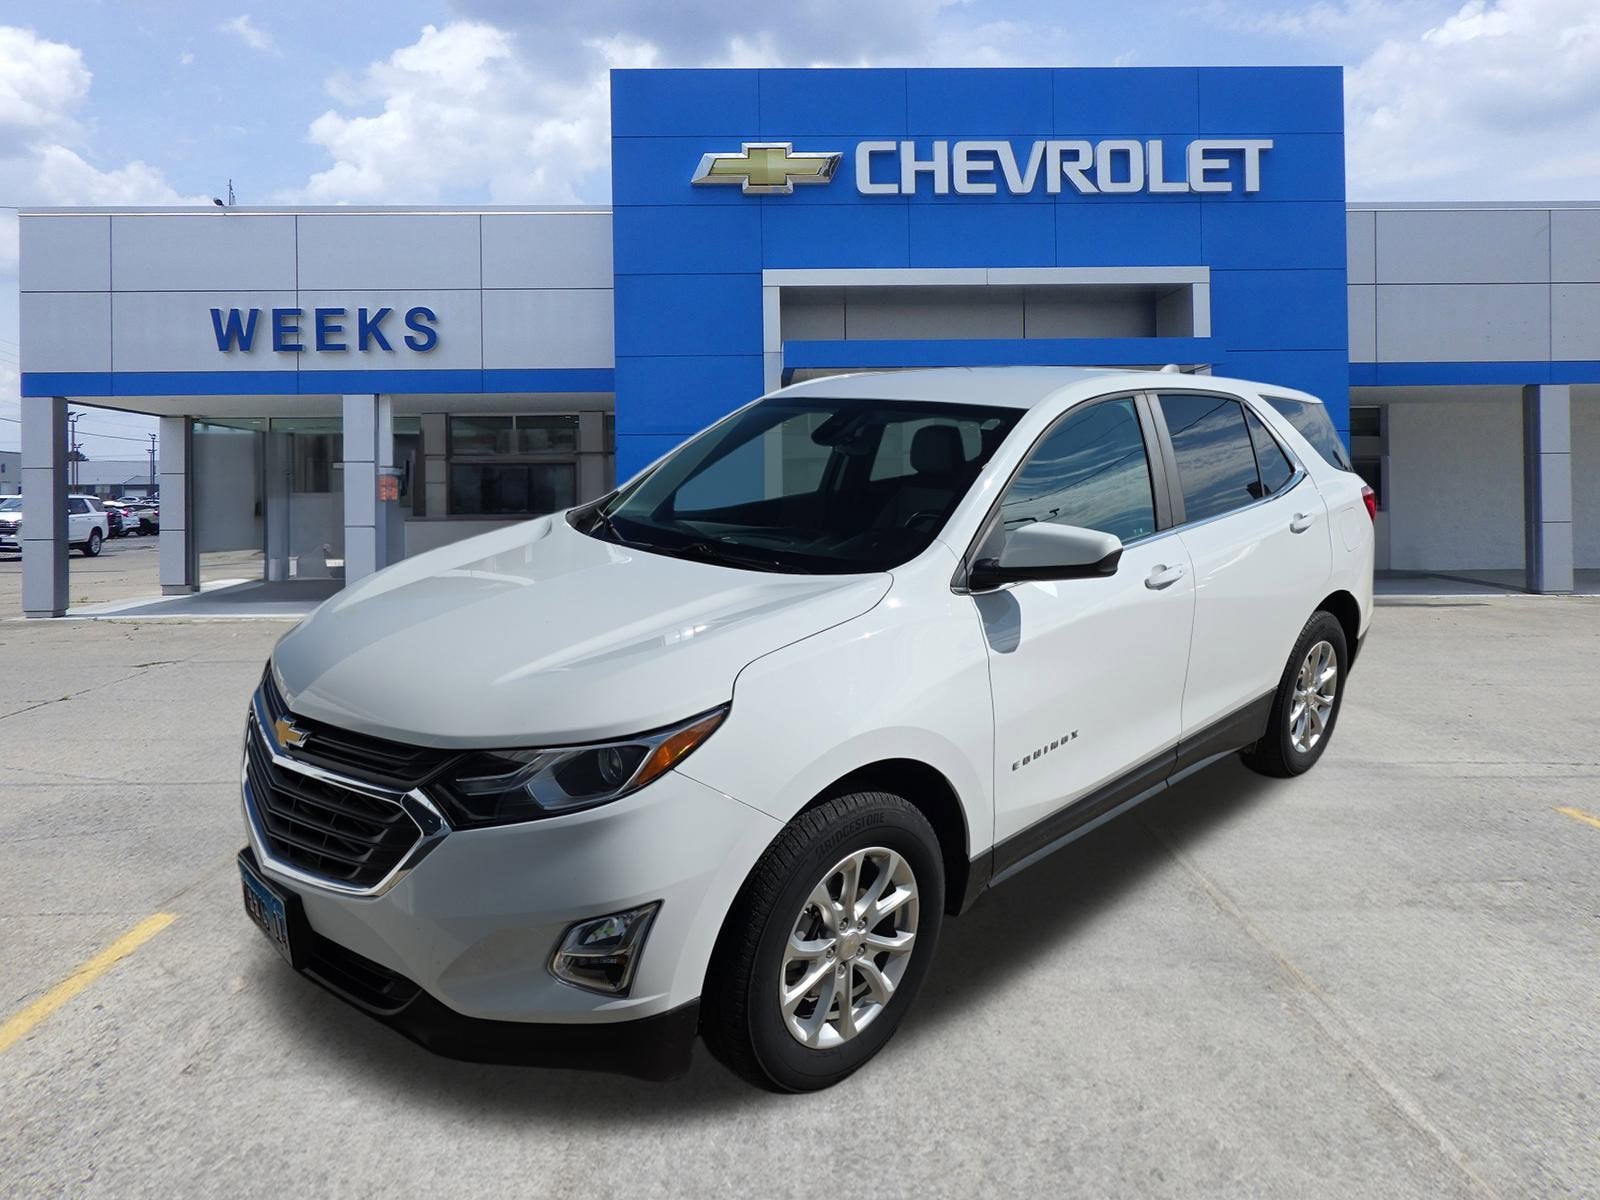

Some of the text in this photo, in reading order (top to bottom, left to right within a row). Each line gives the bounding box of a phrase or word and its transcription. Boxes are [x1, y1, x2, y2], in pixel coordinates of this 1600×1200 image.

[855, 139, 1274, 196] CHEVROLET
[210, 306, 439, 353] WEEKS
[1011, 729, 1079, 772] EQUINOX
[815, 812, 885, 860] BRIDGESTONE
